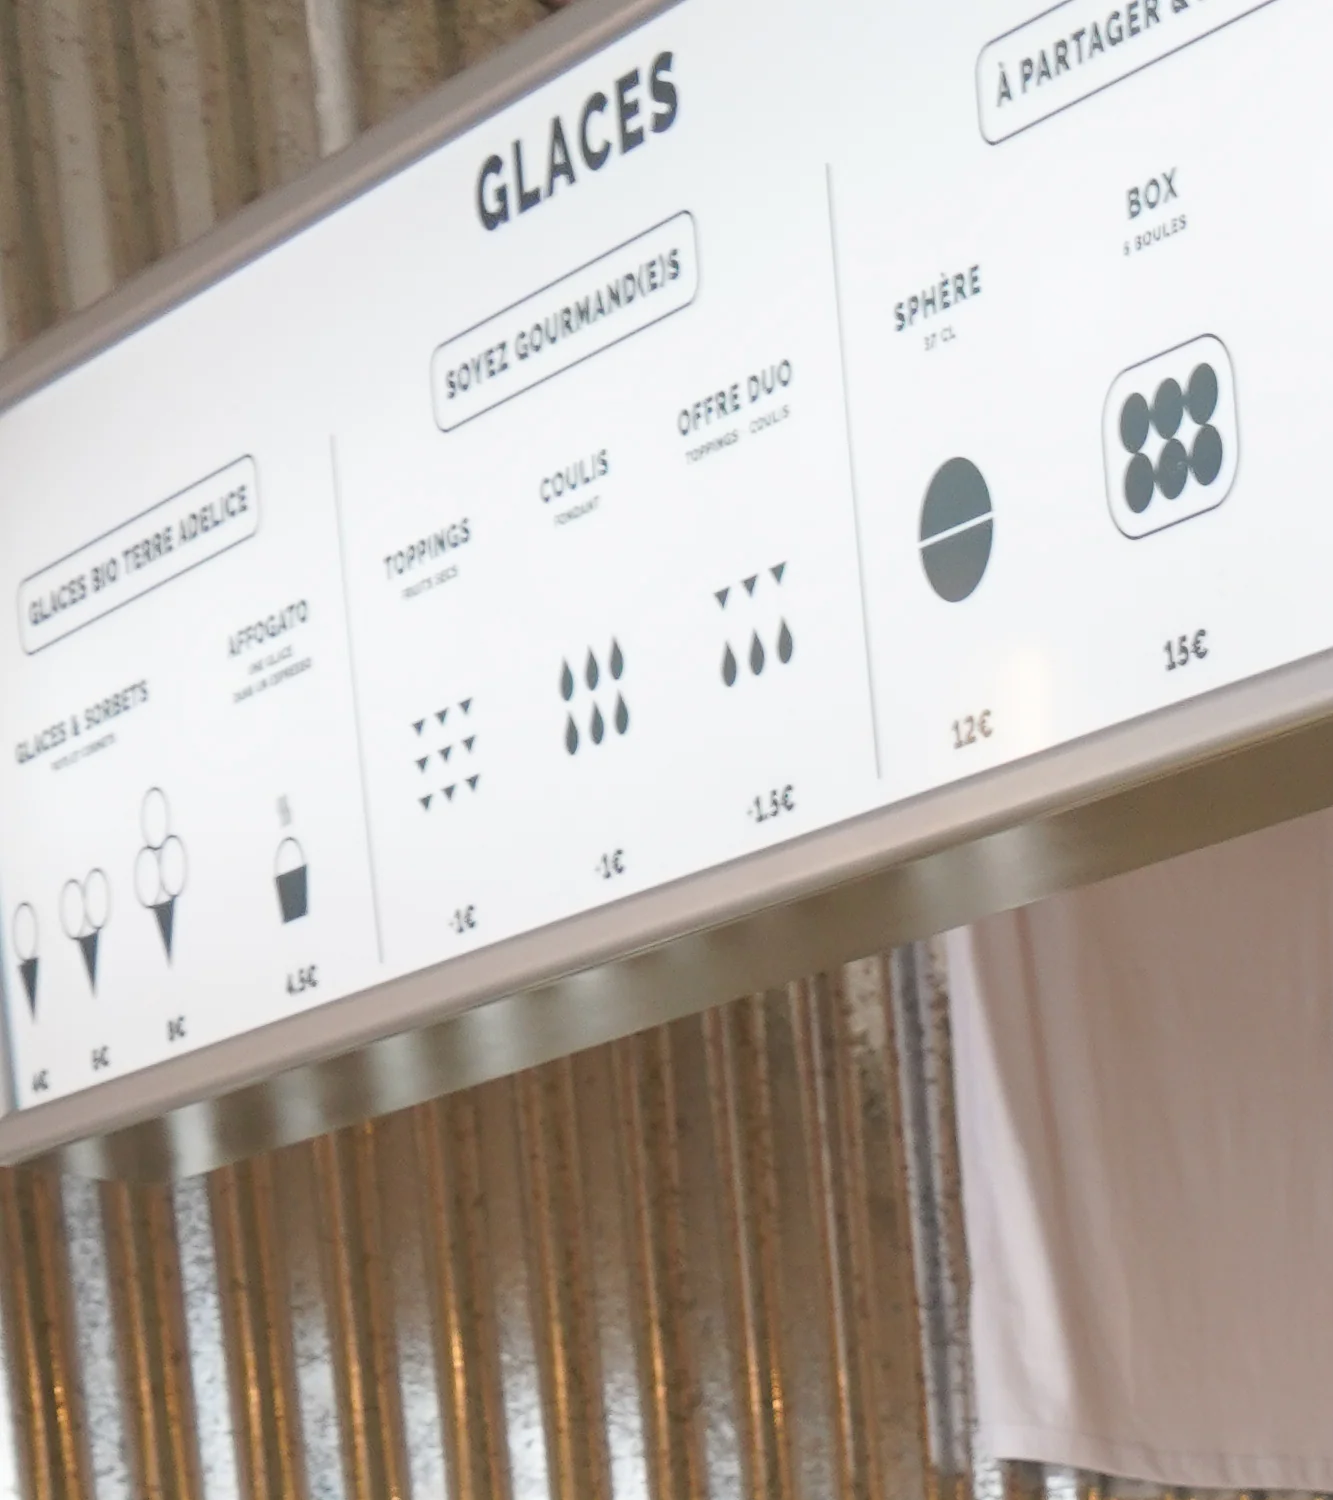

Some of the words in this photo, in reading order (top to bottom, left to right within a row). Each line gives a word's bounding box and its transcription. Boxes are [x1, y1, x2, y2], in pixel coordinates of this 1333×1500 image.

[996, 62, 1012, 107] À
[1020, 0, 1160, 94] PARTAGER
[476, 51, 678, 231] GLACES
[1127, 168, 1177, 219] BOX
[1135, 214, 1187, 251] BOULES
[446, 341, 509, 399] SOYEZ
[516, 249, 680, 360] GOURMAND(E)S
[895, 264, 981, 332] SPHÈRE
[678, 383, 741, 436] OFFRE
[748, 360, 791, 403] DUO
[541, 449, 608, 503] COULIS
[30, 575, 87, 626] GLACES
[91, 558, 117, 592] BIO
[122, 526, 174, 570] TERRE
[180, 485, 248, 542] ADELICE
[384, 518, 470, 575] TOPPINGS
[229, 599, 308, 656] AFFOGATO
[1164, 629, 1208, 671] 15€
[15, 721, 67, 765] GLACES
[85, 680, 148, 730] SORBETS
[952, 709, 993, 749] 12€
